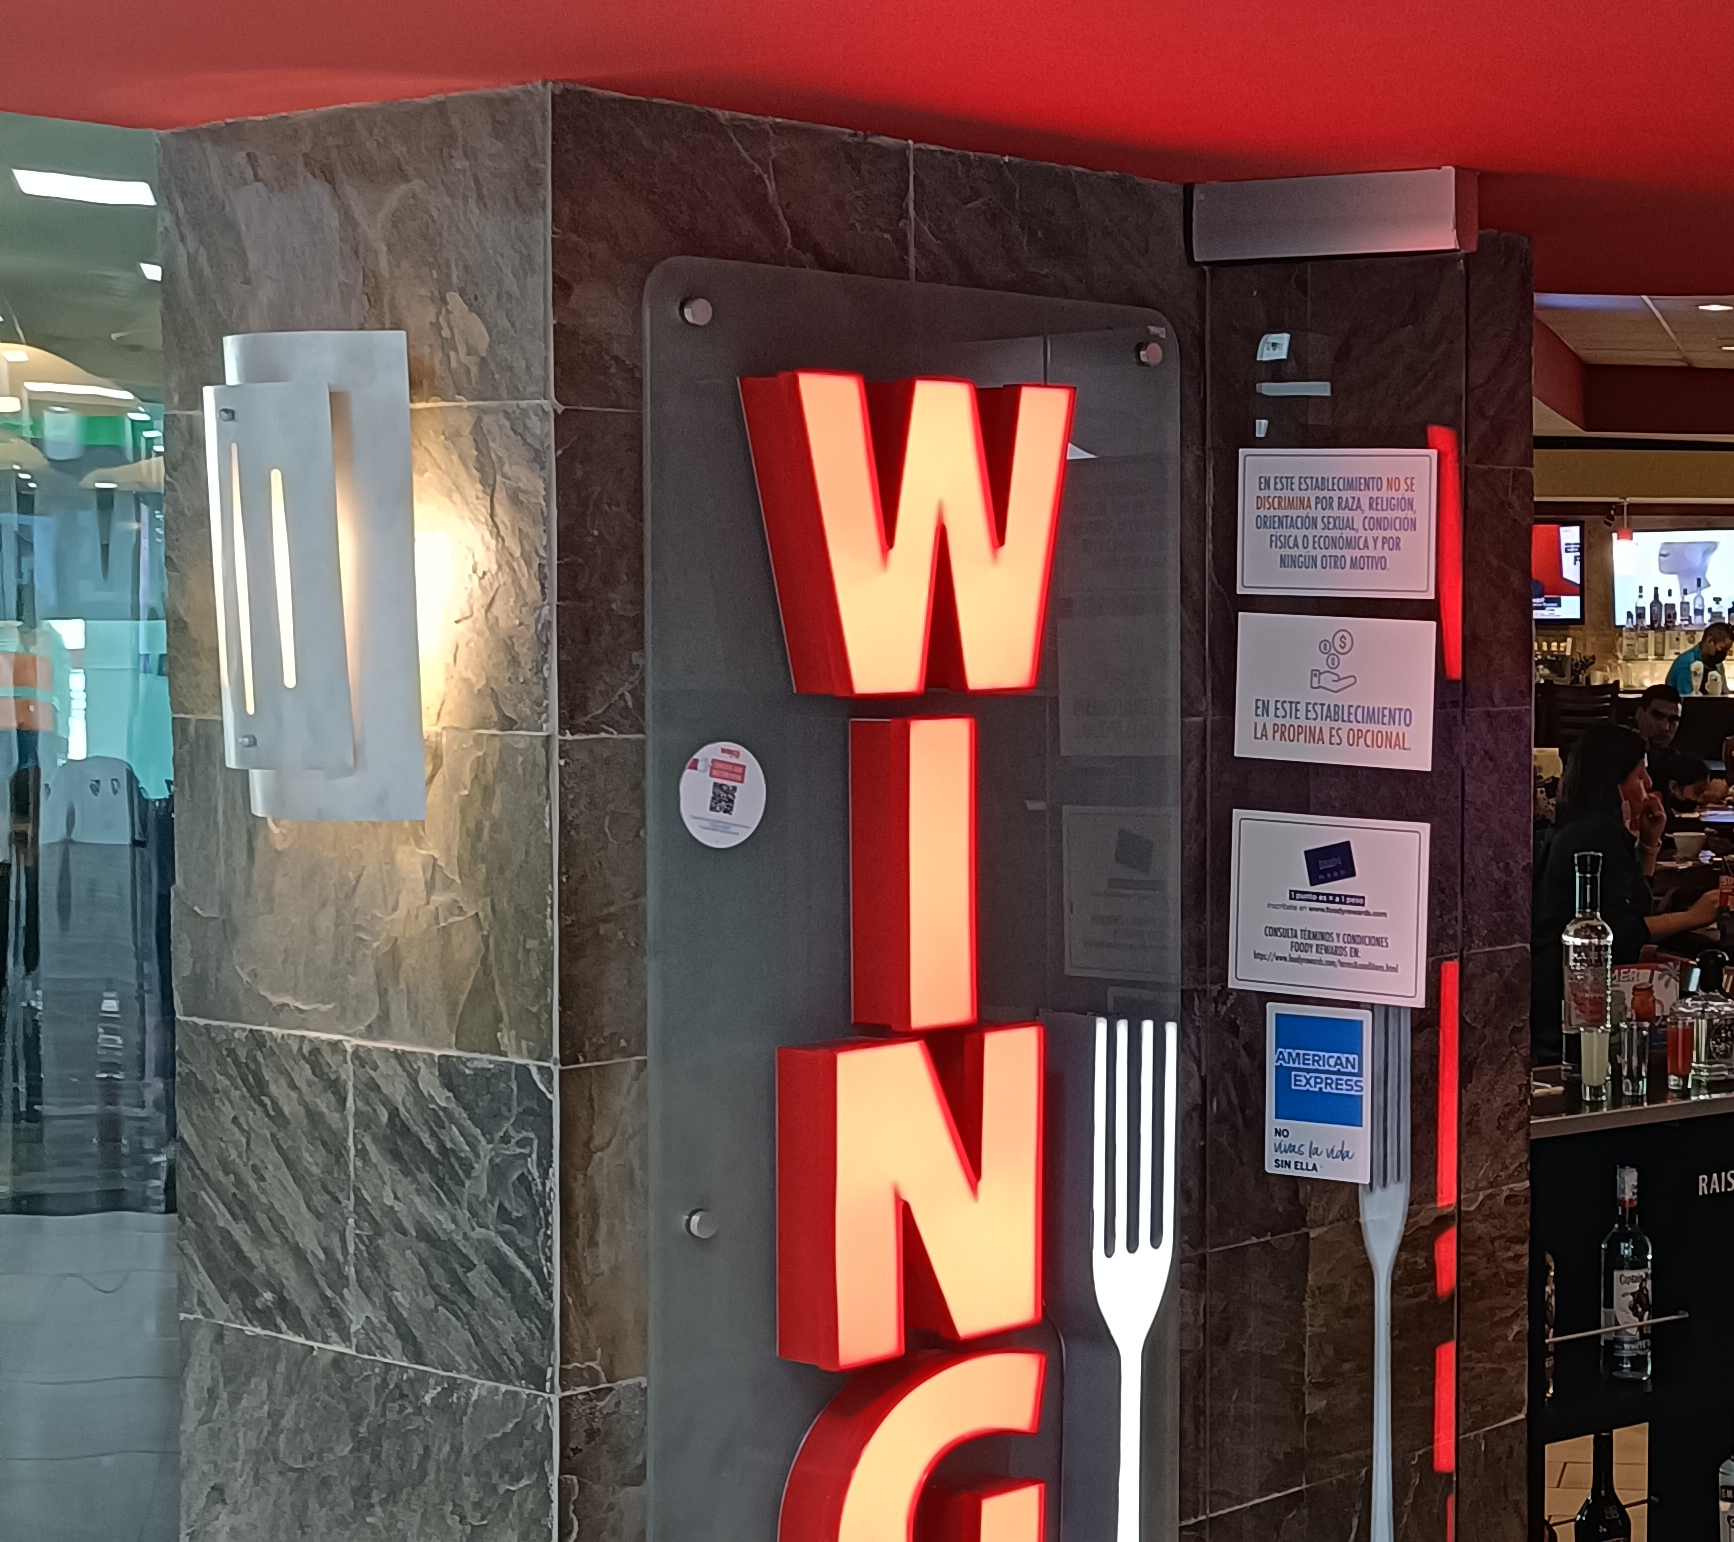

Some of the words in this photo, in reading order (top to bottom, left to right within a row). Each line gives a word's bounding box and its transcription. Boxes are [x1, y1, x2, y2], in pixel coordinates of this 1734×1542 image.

[1258, 475, 1271, 491] EN
[1273, 476, 1295, 491] ESTE
[1298, 476, 1383, 492] ESTABLECIMIENTO
[1386, 476, 1401, 492] NO
[1404, 477, 1415, 492] SE
[1256, 496, 1312, 511] DISCRIMINA
[1315, 496, 1334, 510] POR
[1337, 496, 1365, 514] RAZA,
[1369, 494, 1417, 514] RELIGIÓN,
[1255, 512, 1318, 530] ORIENTACIÓN
[1321, 515, 1358, 533] SEXUAL,
[1362, 513, 1417, 531] CONDICIÓN
[1270, 531, 1299, 549] FÍSICA
[1302, 534, 1309, 549] O
[1312, 532, 1369, 550] ECONÓMICA
[1371, 536, 1379, 550] Y
[1381, 536, 1401, 551] POR
[1279, 551, 1317, 569] NINGÚN
[1320, 554, 1346, 570] OTRO
[1350, 555, 1390, 571] MOTIVO.
[1254, 698, 1270, 718] EN
[1274, 700, 1301, 720] ESTE
[1305, 702, 1413, 727] ESTABLECIMIENTO
[1253, 722, 1268, 740] LA
[1272, 723, 1325, 745] PROPINA
[1329, 727, 1343, 746] ES
[1347, 728, 1411, 751] OPCIONAL.
[1296, 893, 1317, 901] punto
[1264, 926, 1298, 939] CONSULTA
[1300, 927, 1334, 943] TÉRMINOS
[1336, 933, 1341, 943] Y
[1342, 933, 1389, 948] CONDICIONES
[1290, 941, 1314, 953] FOODY
[1316, 944, 1348, 957] REWARDS
[1350, 947, 1361, 958] EN:
[1611, 968, 1640, 983] MER
[1275, 1048, 1359, 1073] AMERICAN
[1291, 1071, 1364, 1096] EXPRESS
[1274, 1128, 1289, 1139] NO
[1274, 1139, 1304, 1155] vivas
[1309, 1140, 1323, 1158] la
[1326, 1140, 1354, 1161] vida
[1274, 1159, 1291, 1170] SIN
[1294, 1160, 1318, 1172] ELLA
